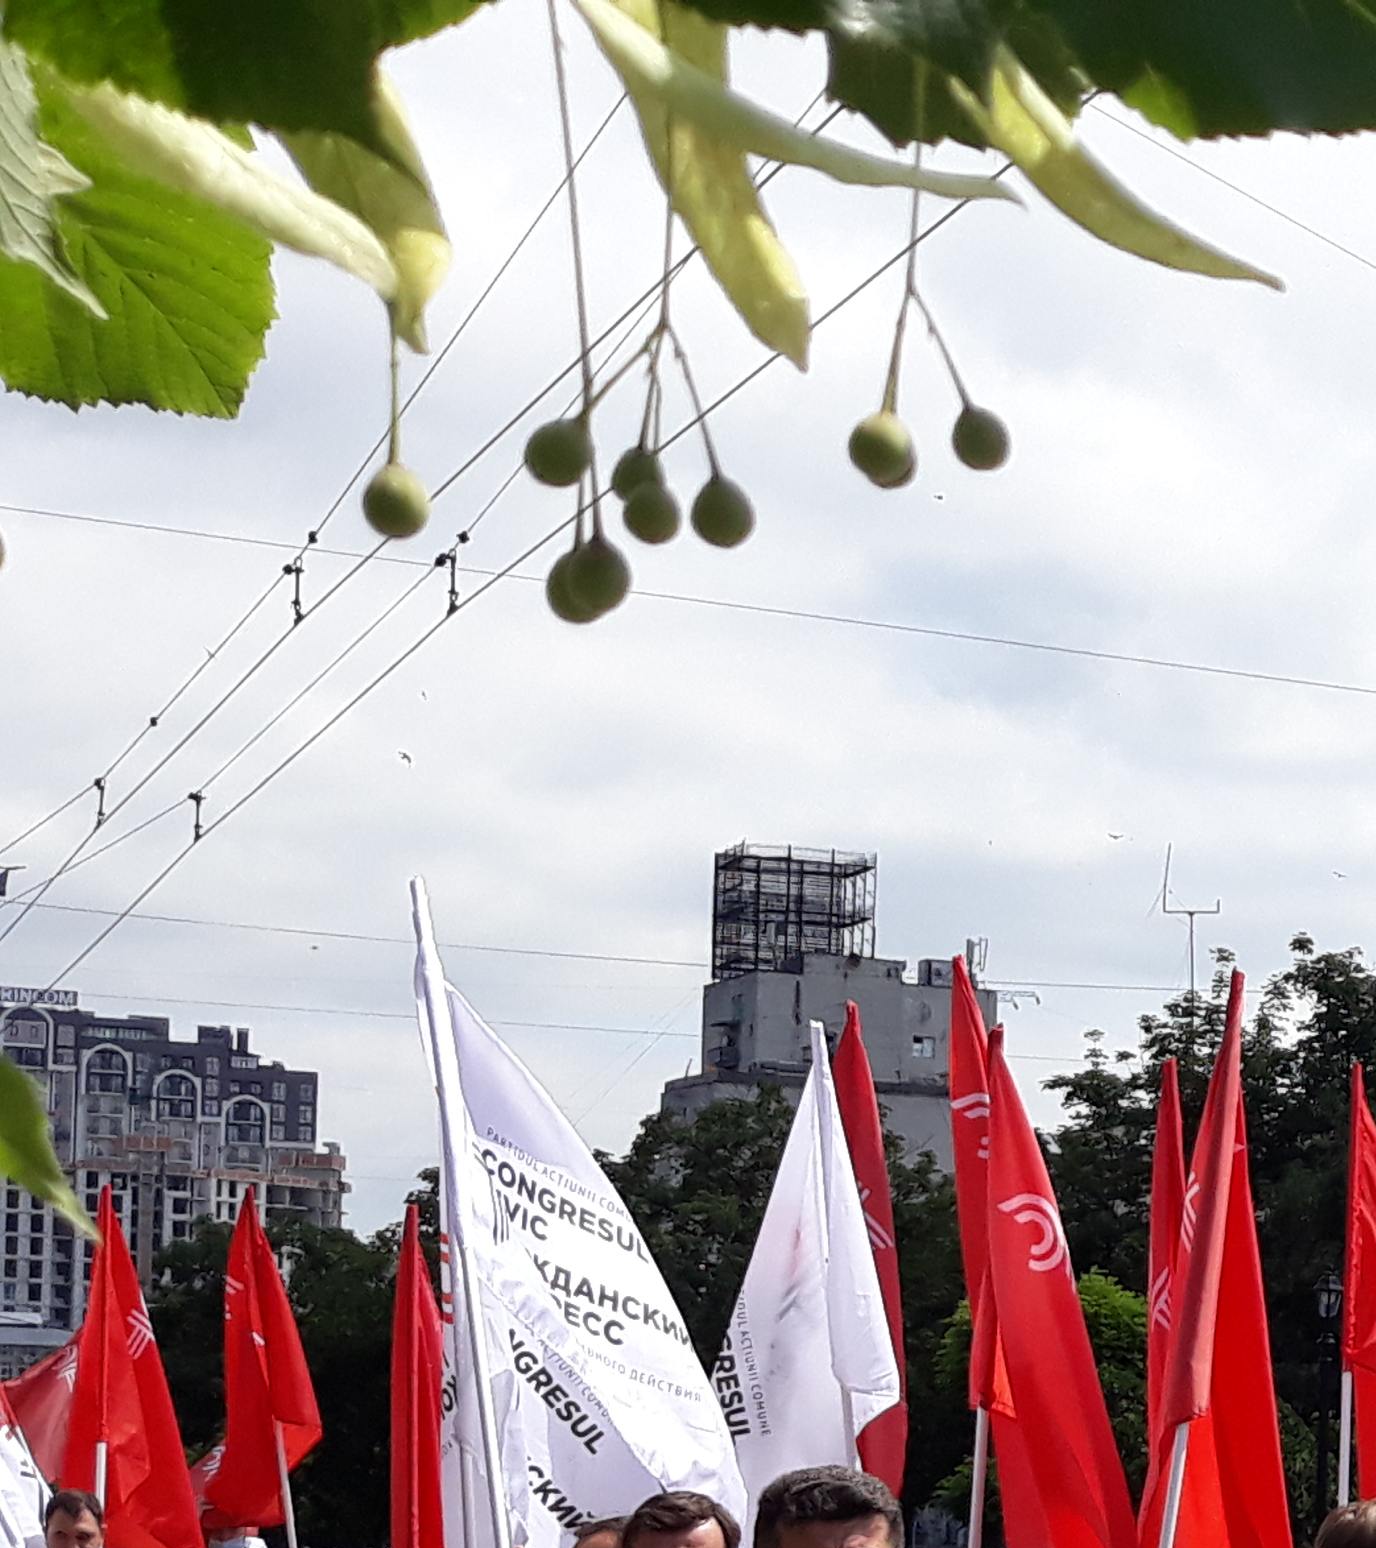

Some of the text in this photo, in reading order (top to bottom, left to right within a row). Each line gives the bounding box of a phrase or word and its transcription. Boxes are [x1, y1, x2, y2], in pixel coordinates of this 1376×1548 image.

[486, 1126, 539, 1173] PARTIDUL
[480, 1148, 651, 1265] CONGRESUL
[750, 1384, 772, 1437] COMUNE
